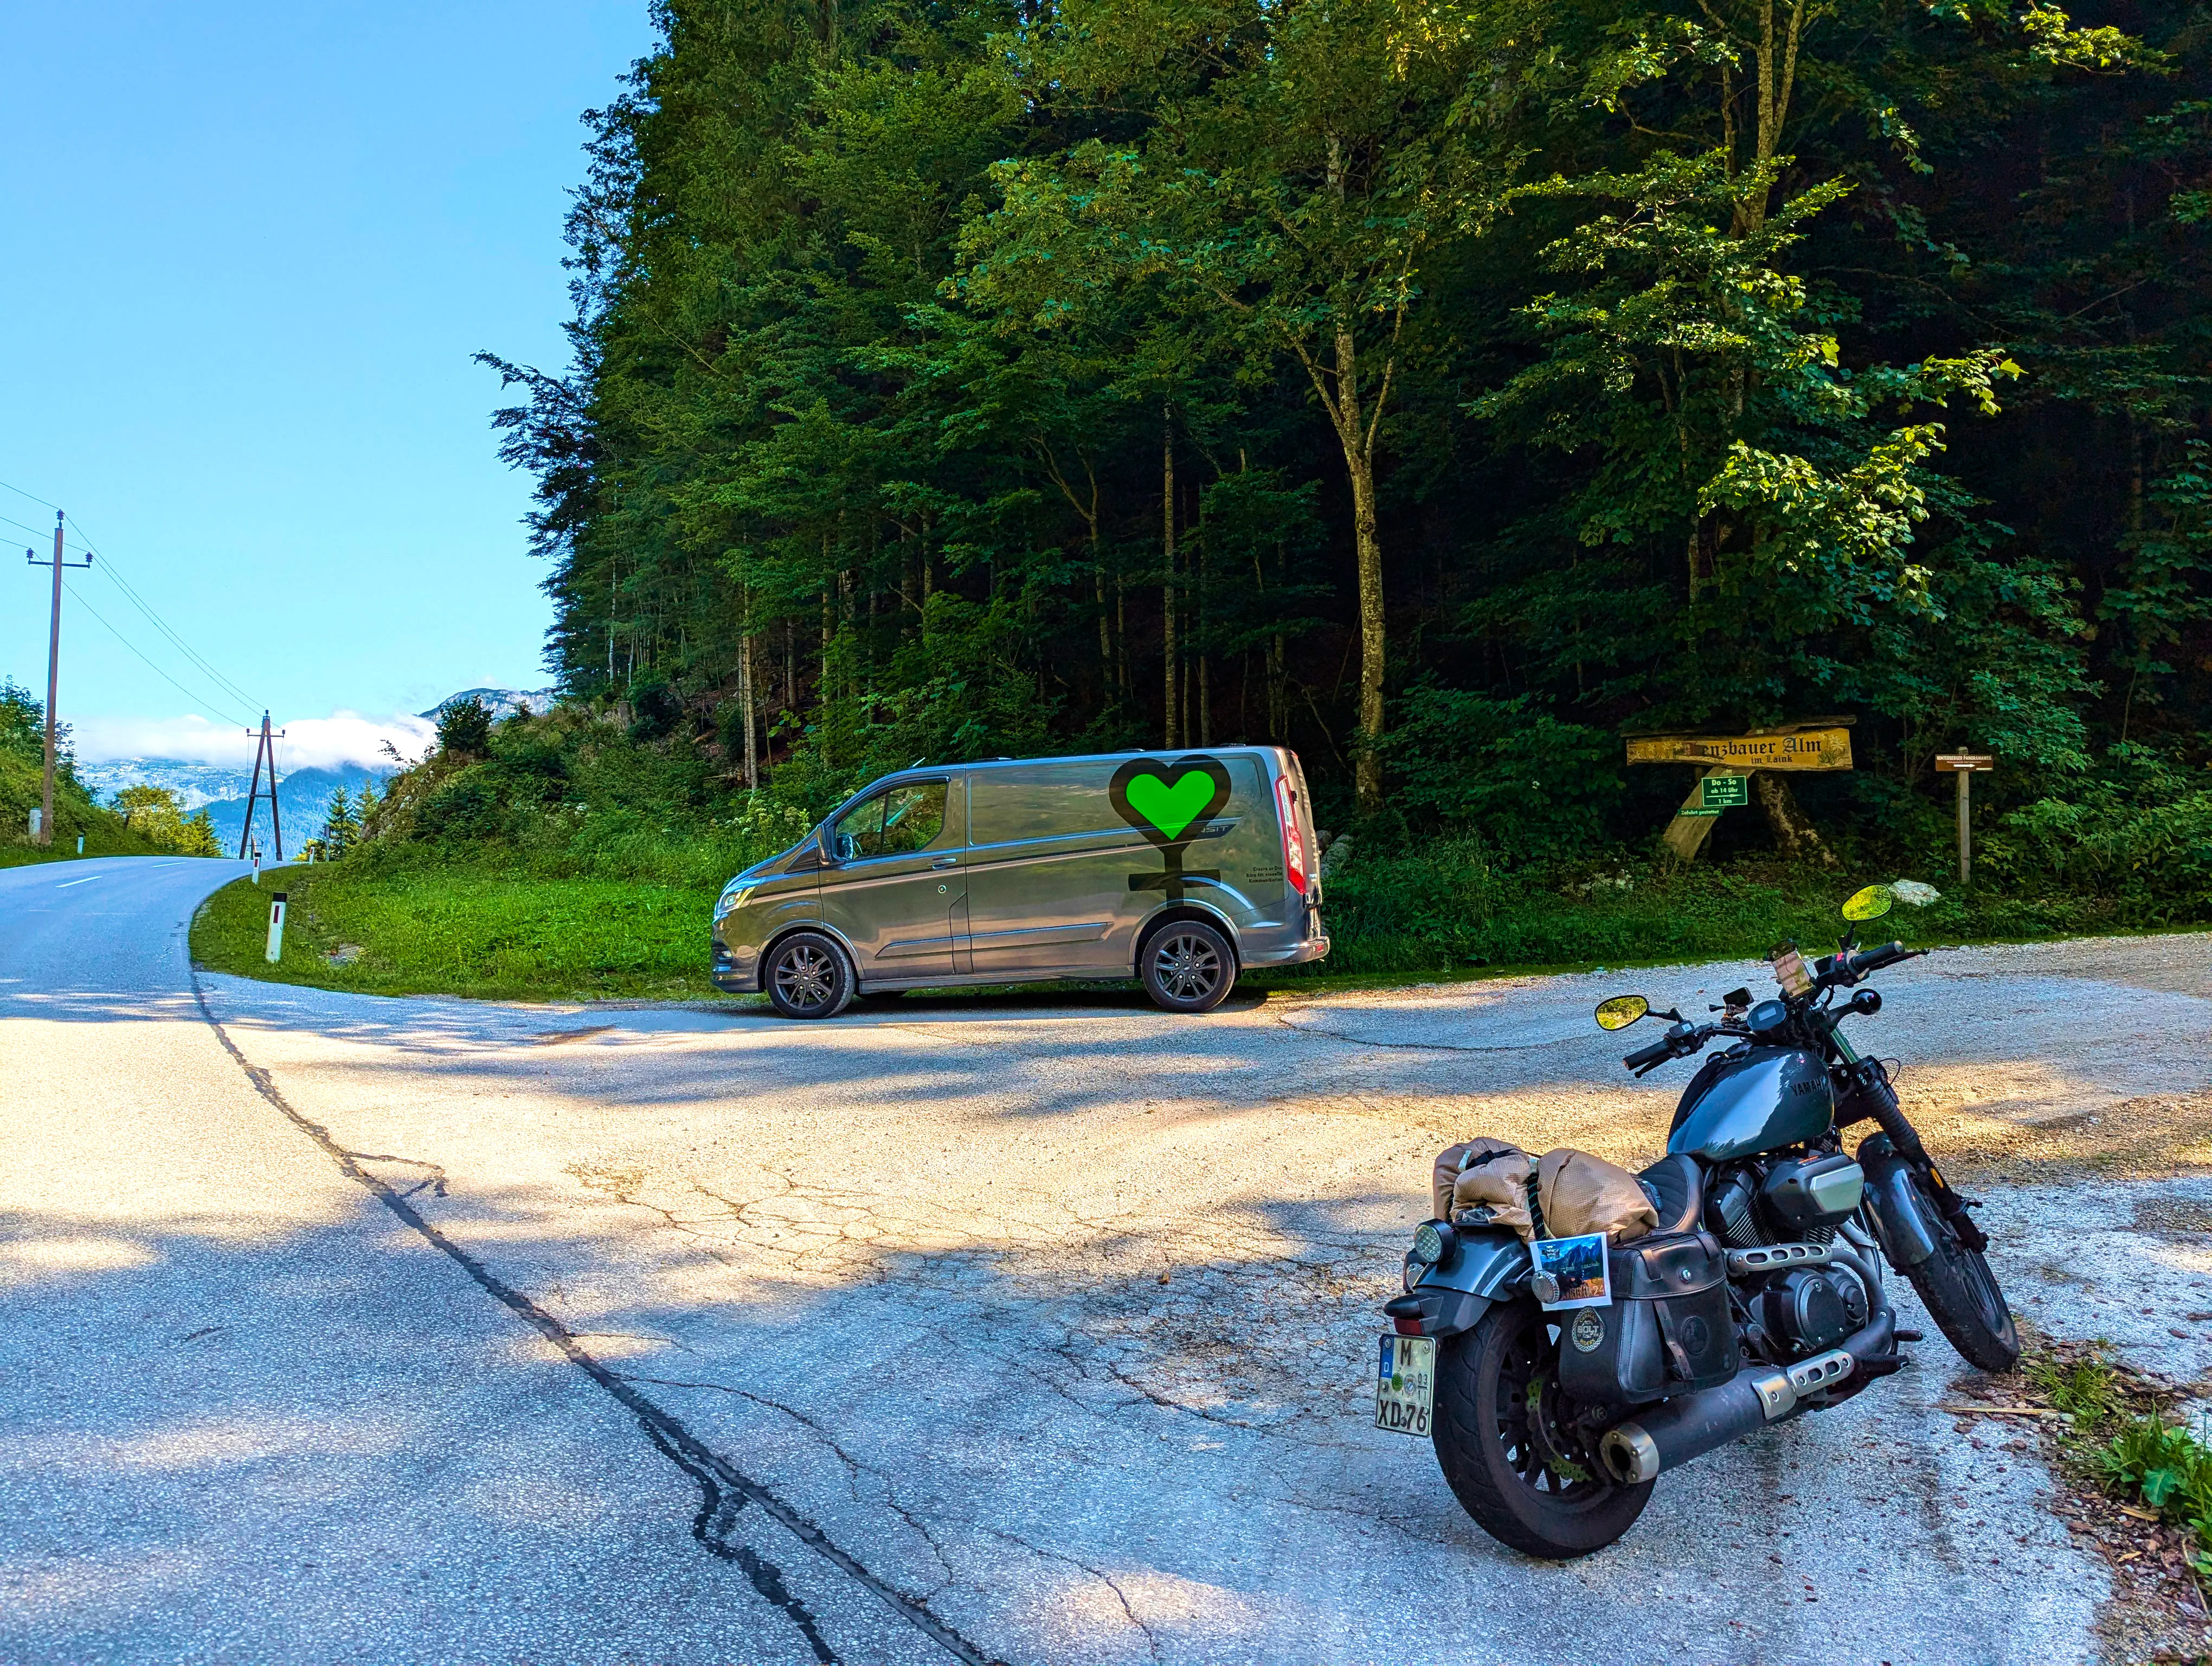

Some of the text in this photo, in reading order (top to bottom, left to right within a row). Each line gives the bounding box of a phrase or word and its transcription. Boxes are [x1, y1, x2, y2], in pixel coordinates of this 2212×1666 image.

[1783, 737, 1822, 753] Alm
[1751, 756, 1763, 764] im
[1790, 1076, 1827, 1097] YAMAH
[1577, 1325, 1599, 1334] BOLT
[1400, 1340, 1412, 1366] M
[1384, 1362, 1390, 1373] D
[1418, 1373, 1428, 1384] 03
[1418, 1389, 1427, 1401] 11
